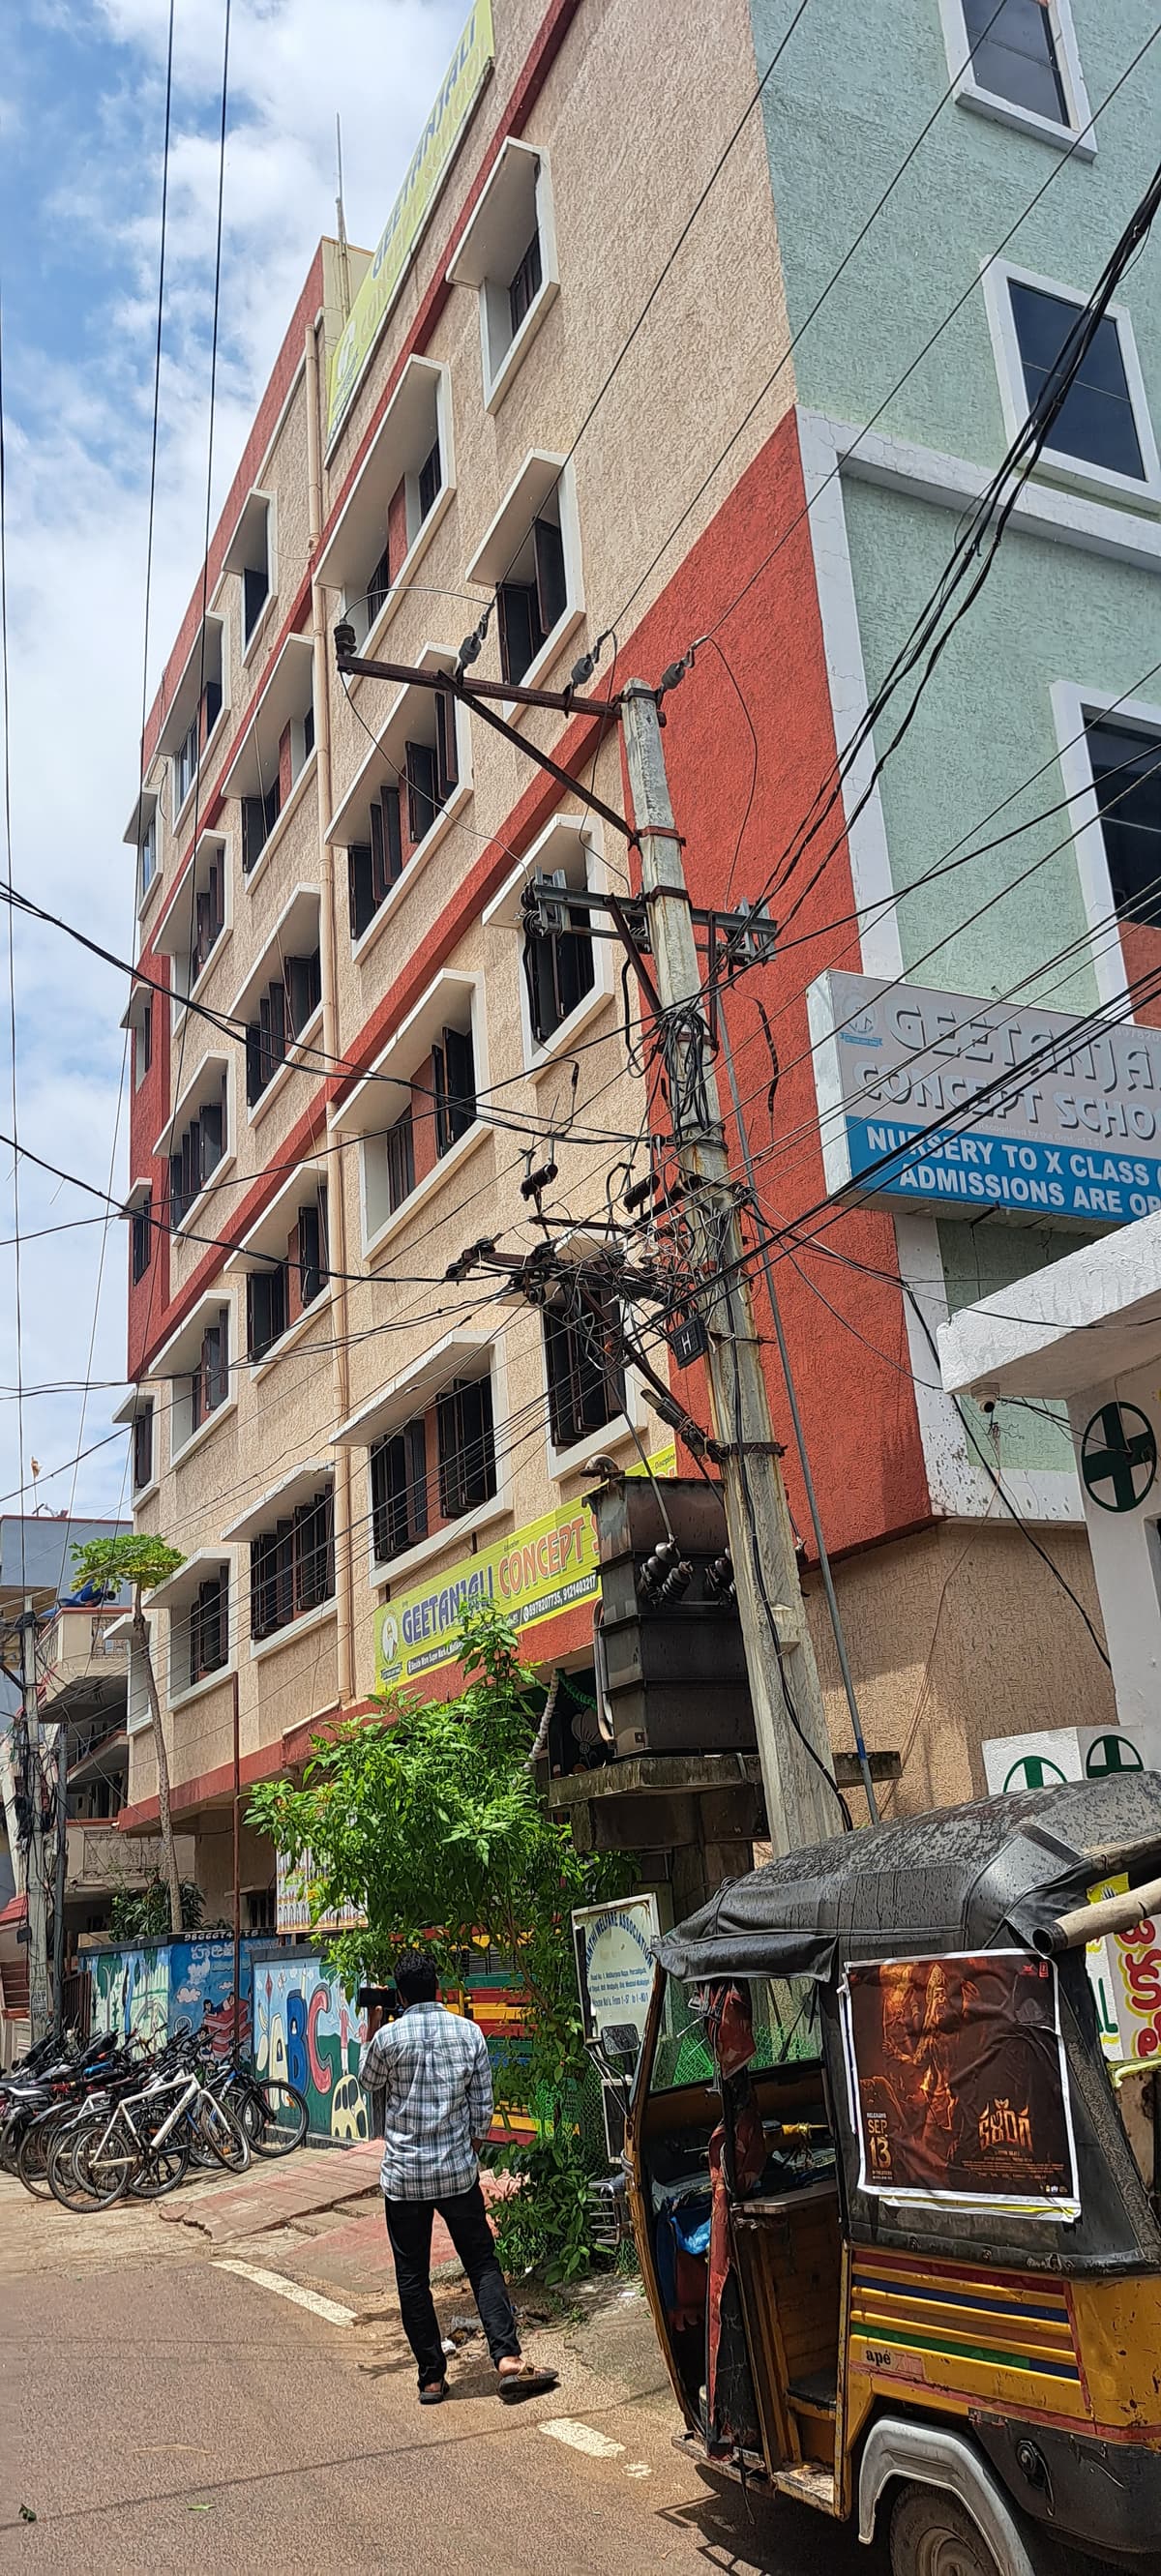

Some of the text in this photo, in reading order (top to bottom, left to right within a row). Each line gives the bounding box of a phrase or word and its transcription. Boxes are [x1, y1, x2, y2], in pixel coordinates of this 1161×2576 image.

[885, 997, 1161, 1094] GEETANJA
[852, 1059, 1161, 1141] CONCEPT SCHO
[866, 1126, 1150, 1186] NURSERY TO X CLASS
[900, 1164, 1064, 1206] ADMISSIONS
[1073, 1187, 1122, 1214] ARE
[497, 1515, 585, 1599] CONCEPT
[867, 2119, 888, 2134] SEP
[869, 2136, 892, 2169] 13
[866, 2350, 891, 2367] apé
